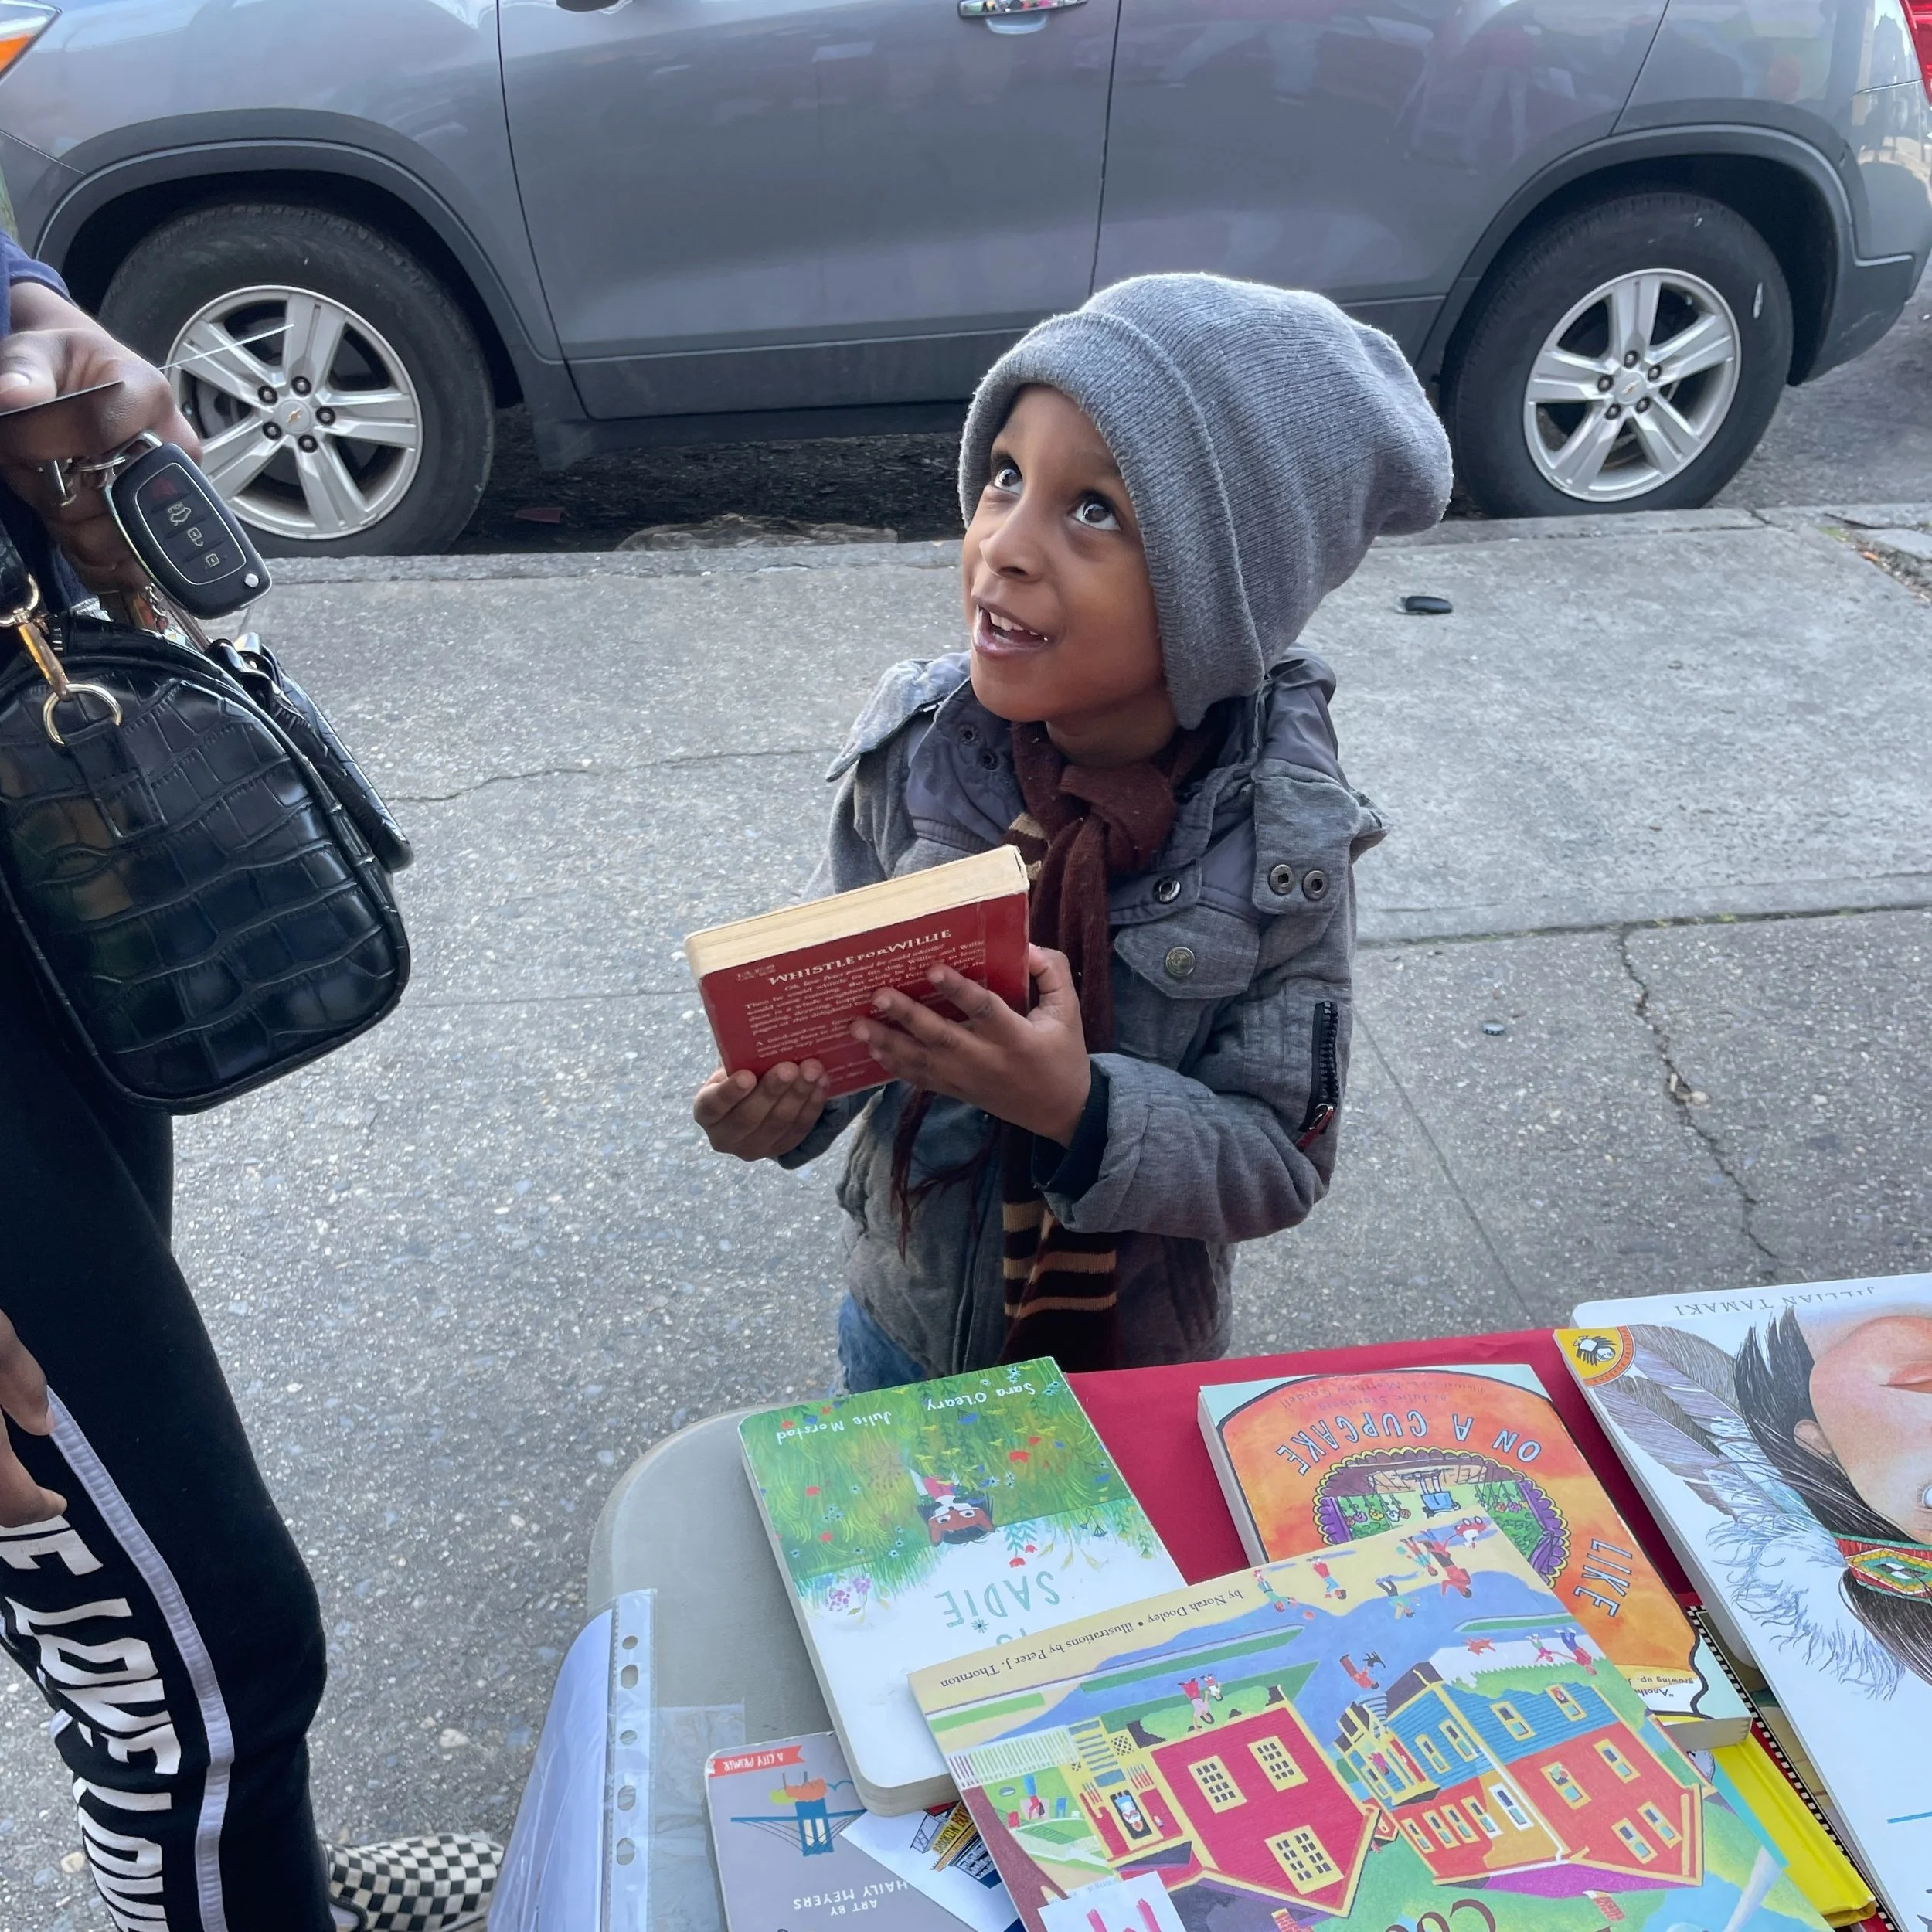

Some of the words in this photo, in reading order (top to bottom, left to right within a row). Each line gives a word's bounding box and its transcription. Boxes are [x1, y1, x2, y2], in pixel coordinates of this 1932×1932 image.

[767, 956, 855, 985] WHISTLE
[857, 947, 888, 960] FOR
[885, 929, 952, 954] WILLIE
[1674, 1297, 1774, 1316] TAMAKI
[1782, 1287, 1876, 1307] JILLIAN
[995, 1382, 1036, 1397] Sara
[1397, 1393, 1433, 1403] Julie
[927, 1394, 987, 1411] O'Leary
[1280, 1390, 1332, 1409] Cordell
[1317, 1396, 1388, 1410] Sternberg
[852, 1410, 893, 1427] Julie
[1452, 1413, 1474, 1441] A
[776, 1420, 844, 1445] Morstad
[1275, 1410, 1428, 1475] CUPCAKE
[1492, 1429, 1541, 1462] ON
[1573, 1539, 1632, 1617] LIKE
[934, 1571, 1060, 1628] SADIE
[1229, 1588, 1244, 1600] by
[1192, 1594, 1228, 1615] Norah
[1148, 1605, 1189, 1624] Dooley
[1066, 1621, 1133, 1647] illustrations
[1016, 1648, 1047, 1664] Peter
[1049, 1644, 1066, 1655] by
[1001, 1658, 1013, 1669] J.
[5, 1597, 182, 1774] LOVE
[940, 1665, 1000, 1687] Thornton
[723, 1757, 754, 1771] PRIMER
[757, 1753, 774, 1767] CITY
[777, 1753, 784, 1761] A
[933, 1824, 961, 1855] BROOKLYN
[862, 1880, 908, 1897] HAILY
[793, 1889, 855, 1910] MEYERS
[852, 1899, 877, 1912] ART
[830, 1905, 845, 1916] BY
